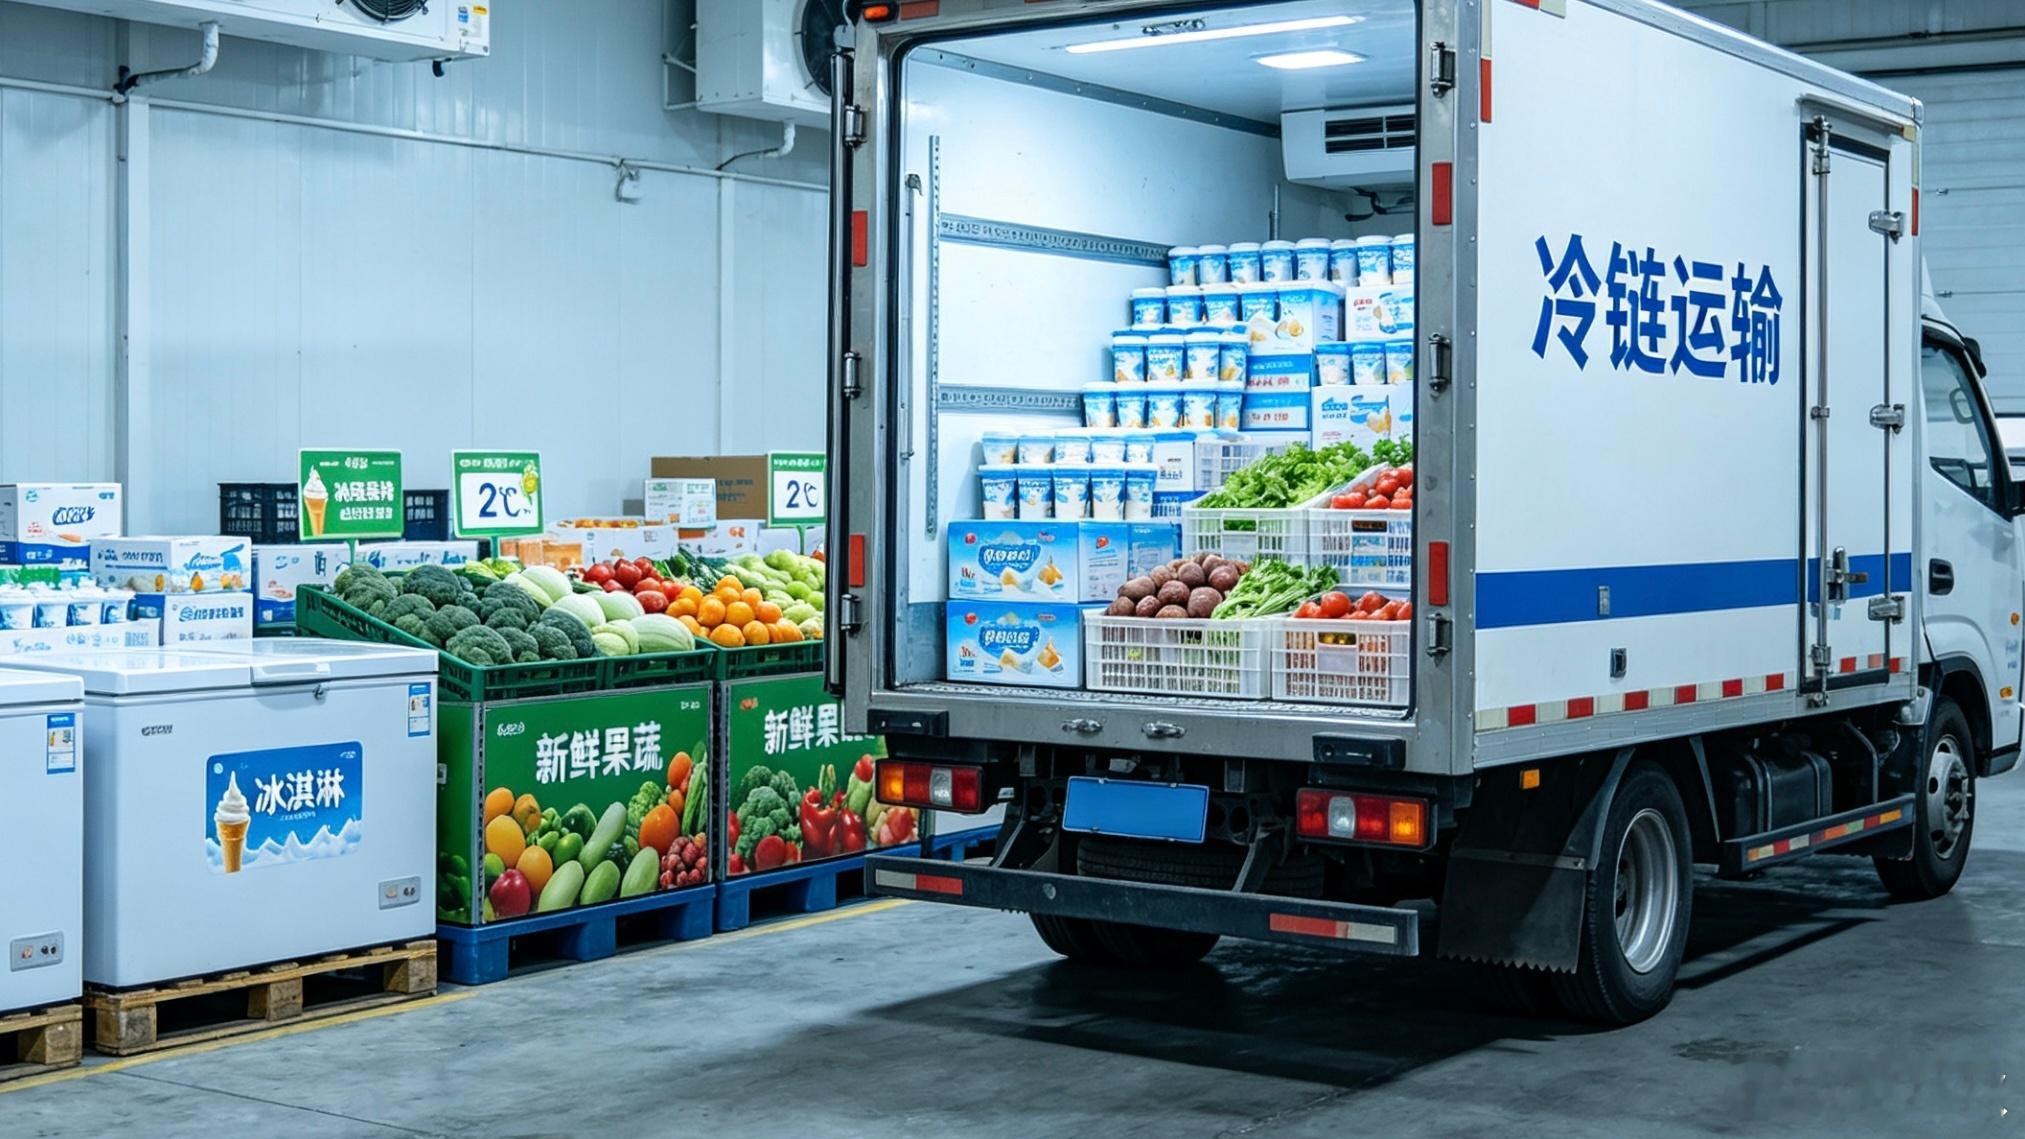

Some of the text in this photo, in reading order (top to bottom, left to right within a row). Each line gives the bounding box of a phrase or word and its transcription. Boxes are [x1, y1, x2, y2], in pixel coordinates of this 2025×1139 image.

[1531, 233, 1783, 386] 冷链运输
[536, 720, 663, 784] 新鲜果蔬
[764, 703, 876, 755] 新鲜果
[254, 767, 346, 816] 冰淇淋
